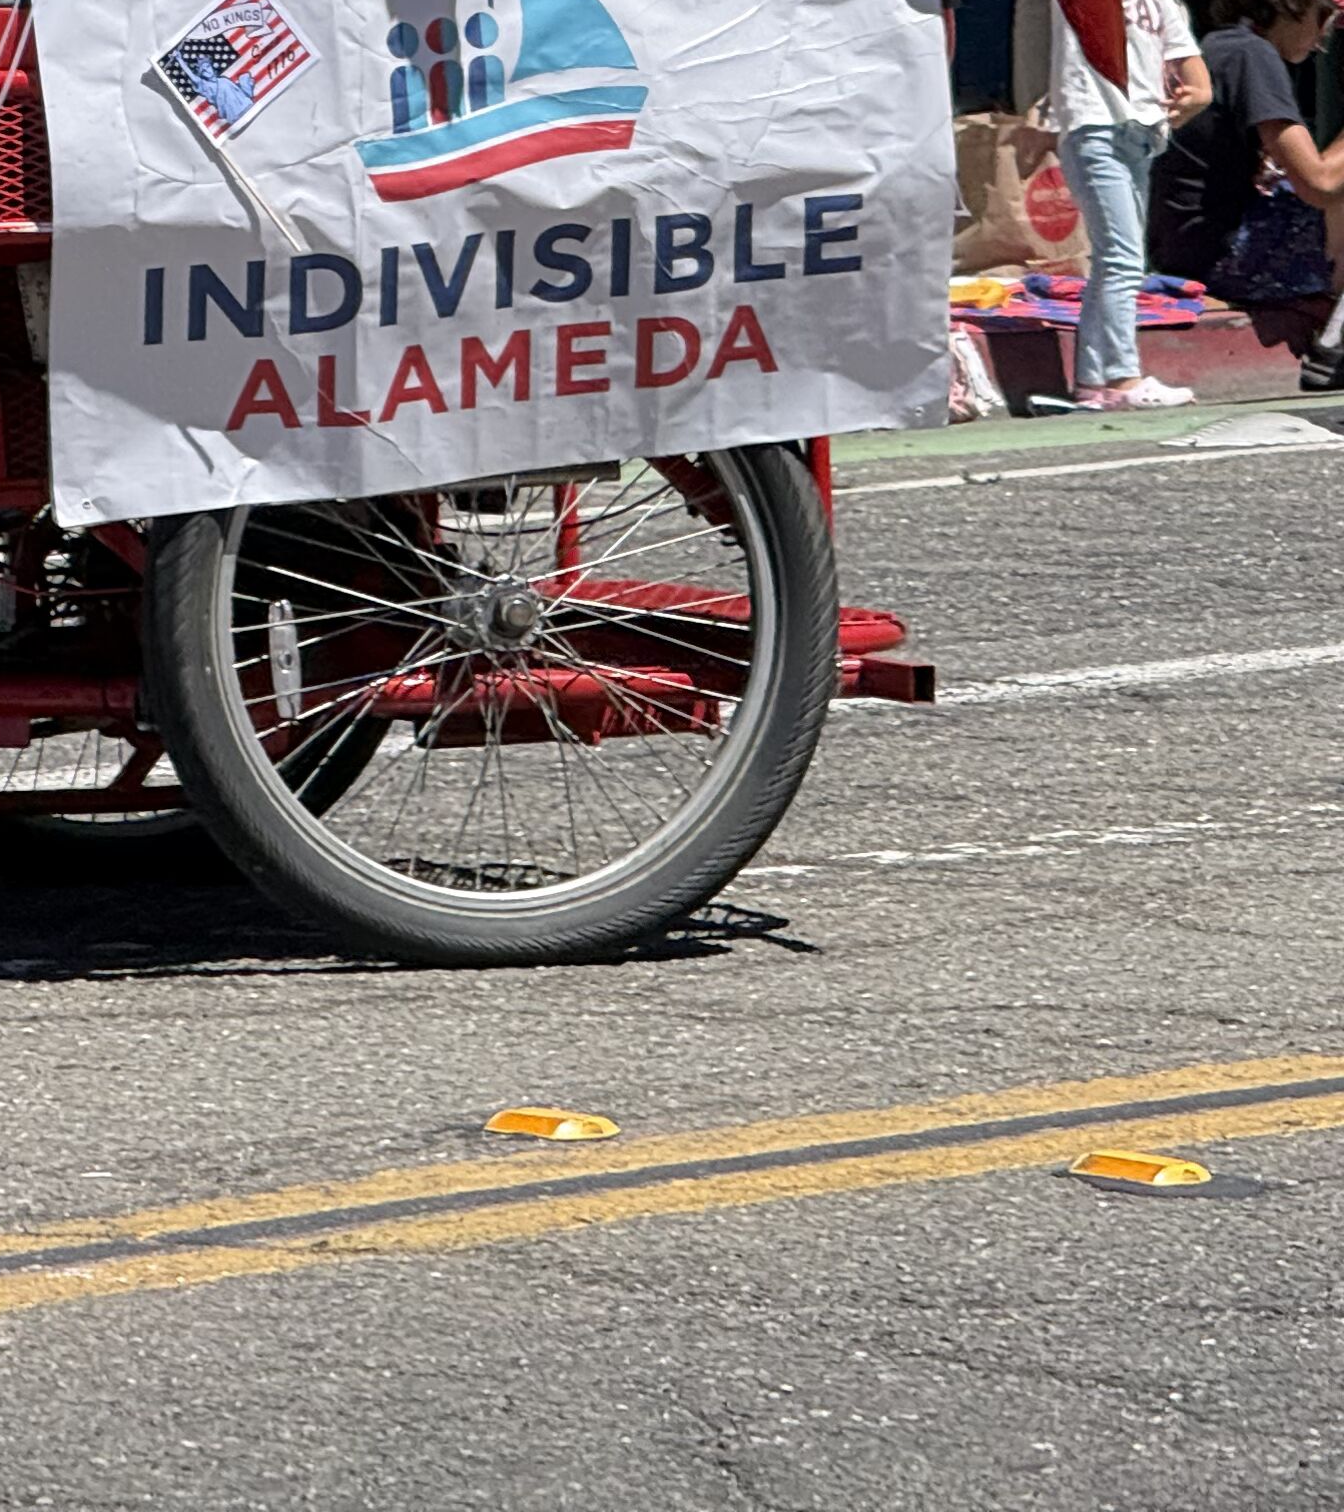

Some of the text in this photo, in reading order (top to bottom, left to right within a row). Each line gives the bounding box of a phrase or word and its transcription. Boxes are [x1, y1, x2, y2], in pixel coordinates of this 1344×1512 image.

[201, 9, 261, 33] NO KINGS
[143, 193, 863, 346] INDIVISIBLE
[226, 304, 779, 432] ALAMEDA
